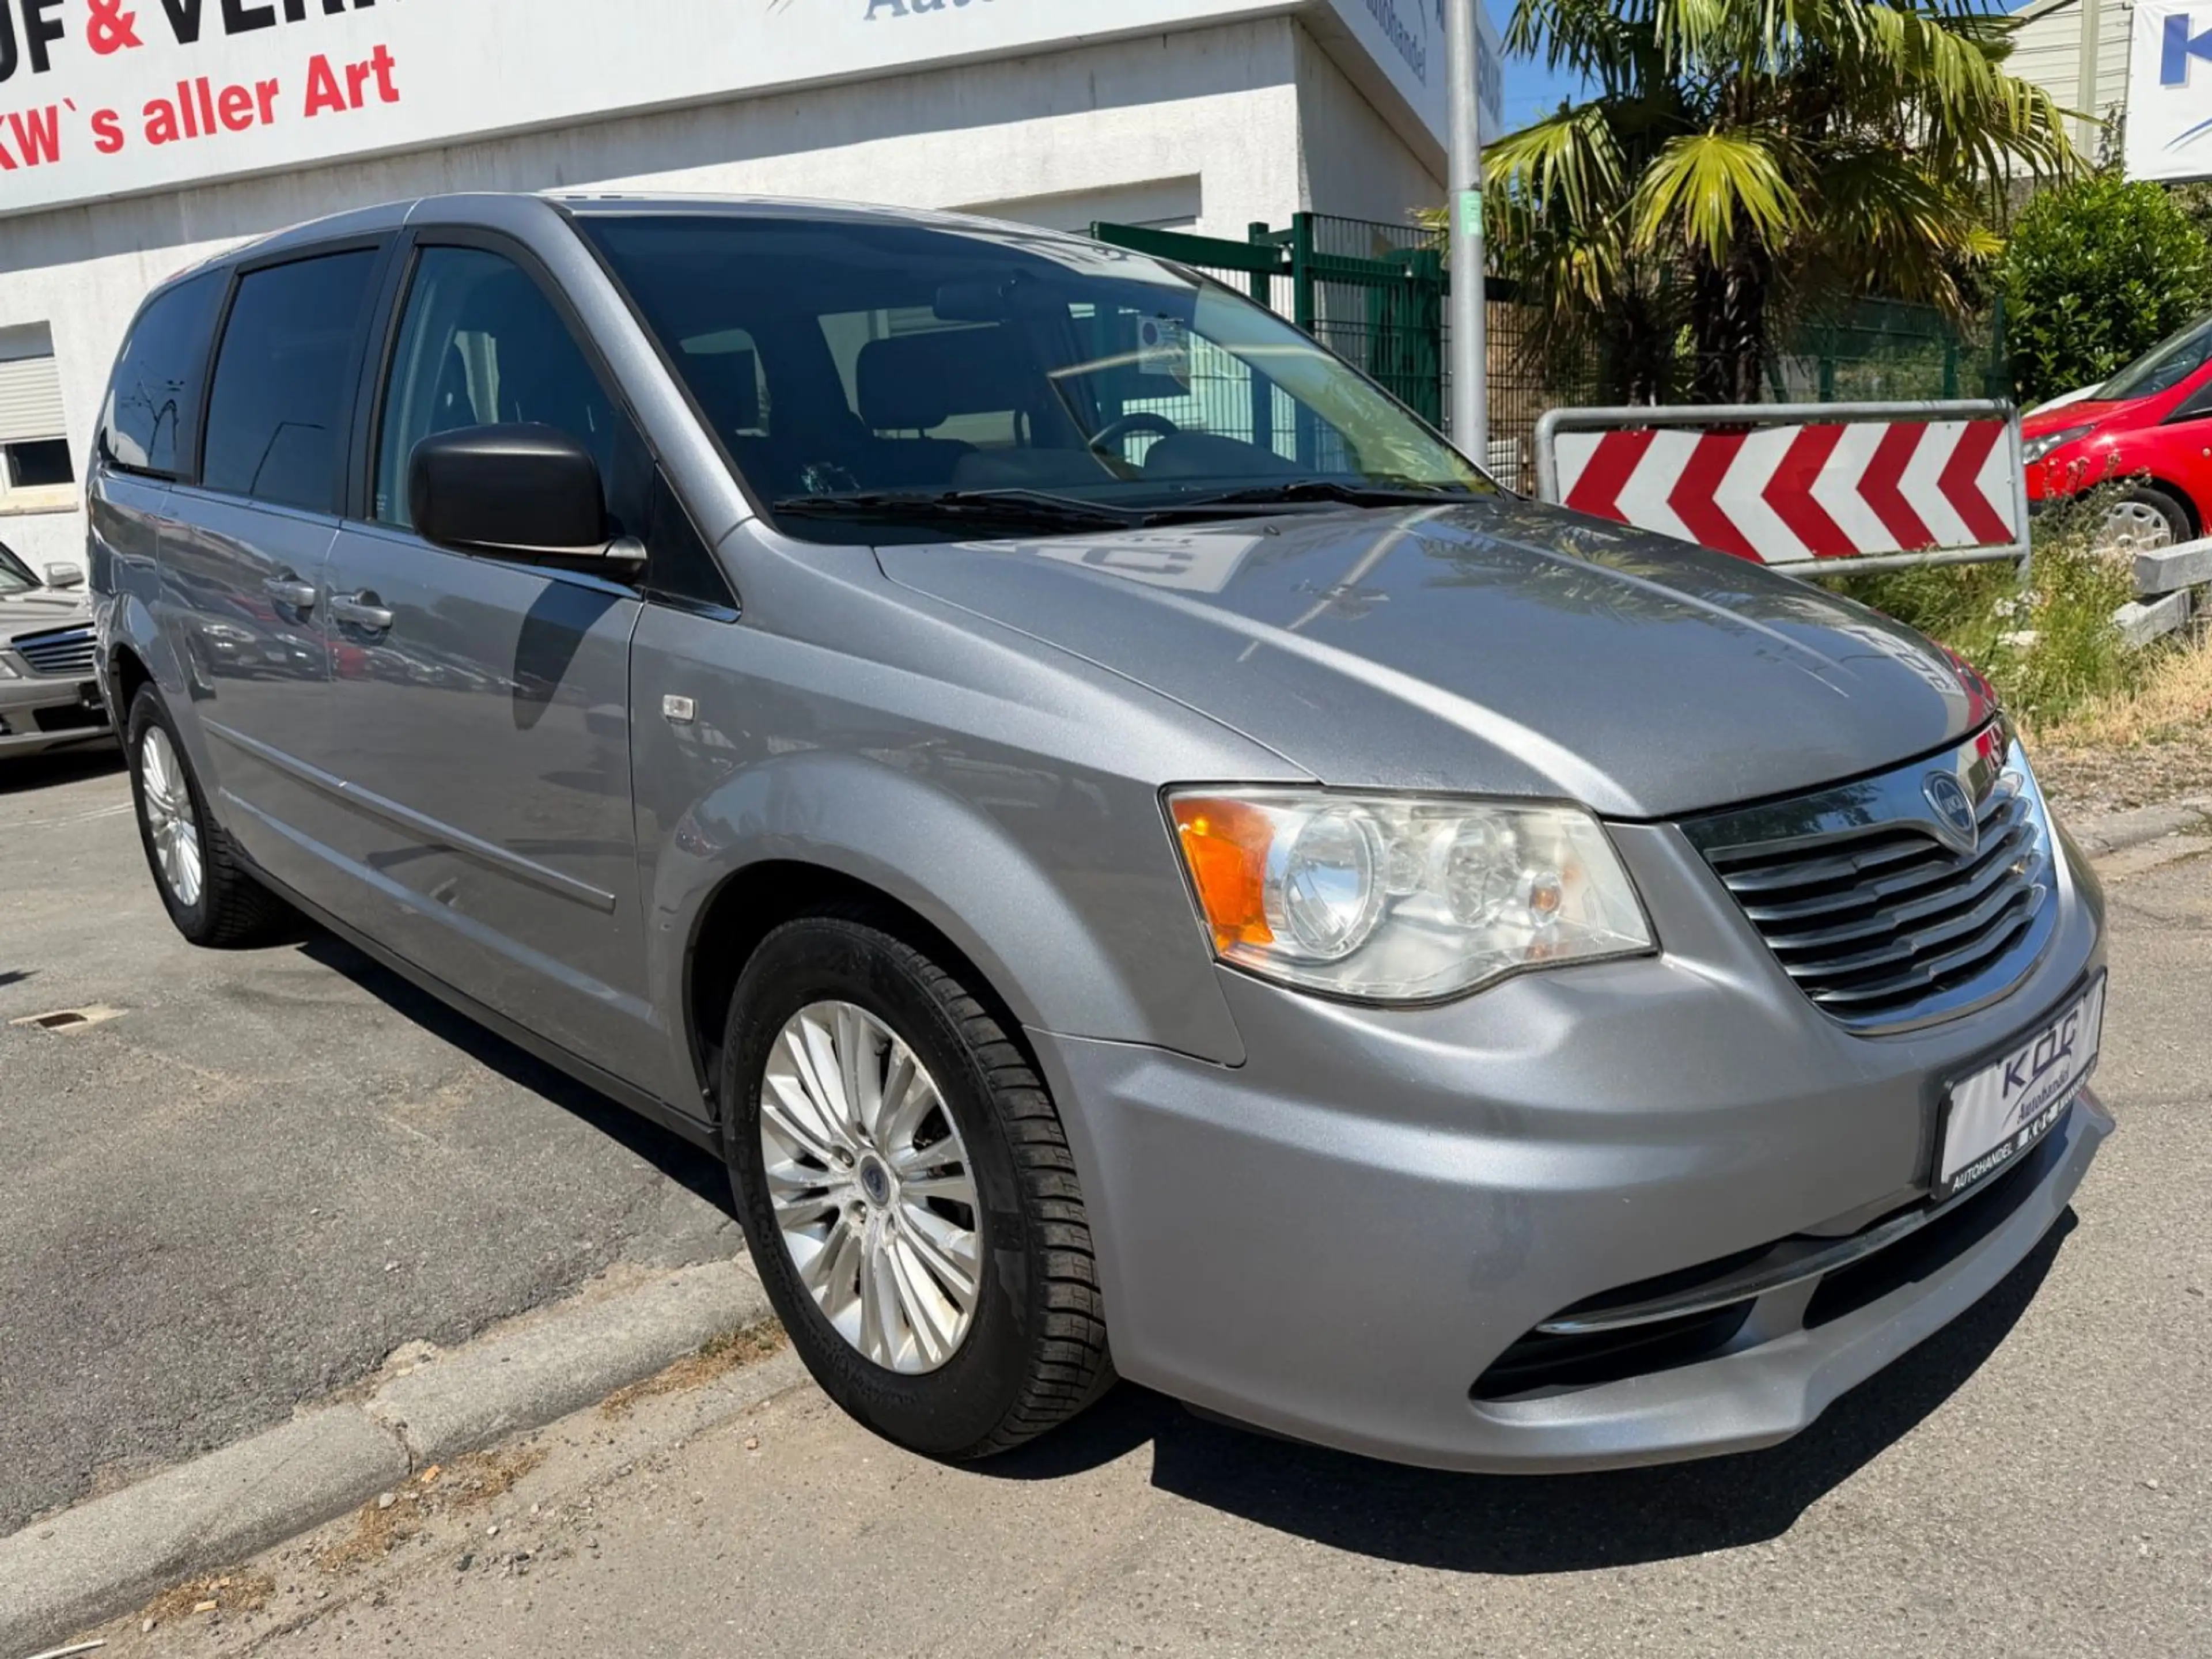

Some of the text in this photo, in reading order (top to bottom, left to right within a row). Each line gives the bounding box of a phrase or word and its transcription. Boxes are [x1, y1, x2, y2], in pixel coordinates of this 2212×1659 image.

[86, 0, 144, 55] &
[143, 77, 279, 145] aller
[304, 44, 400, 118] Art
[1952, 1142, 2014, 1194] AUTOHANDEL
